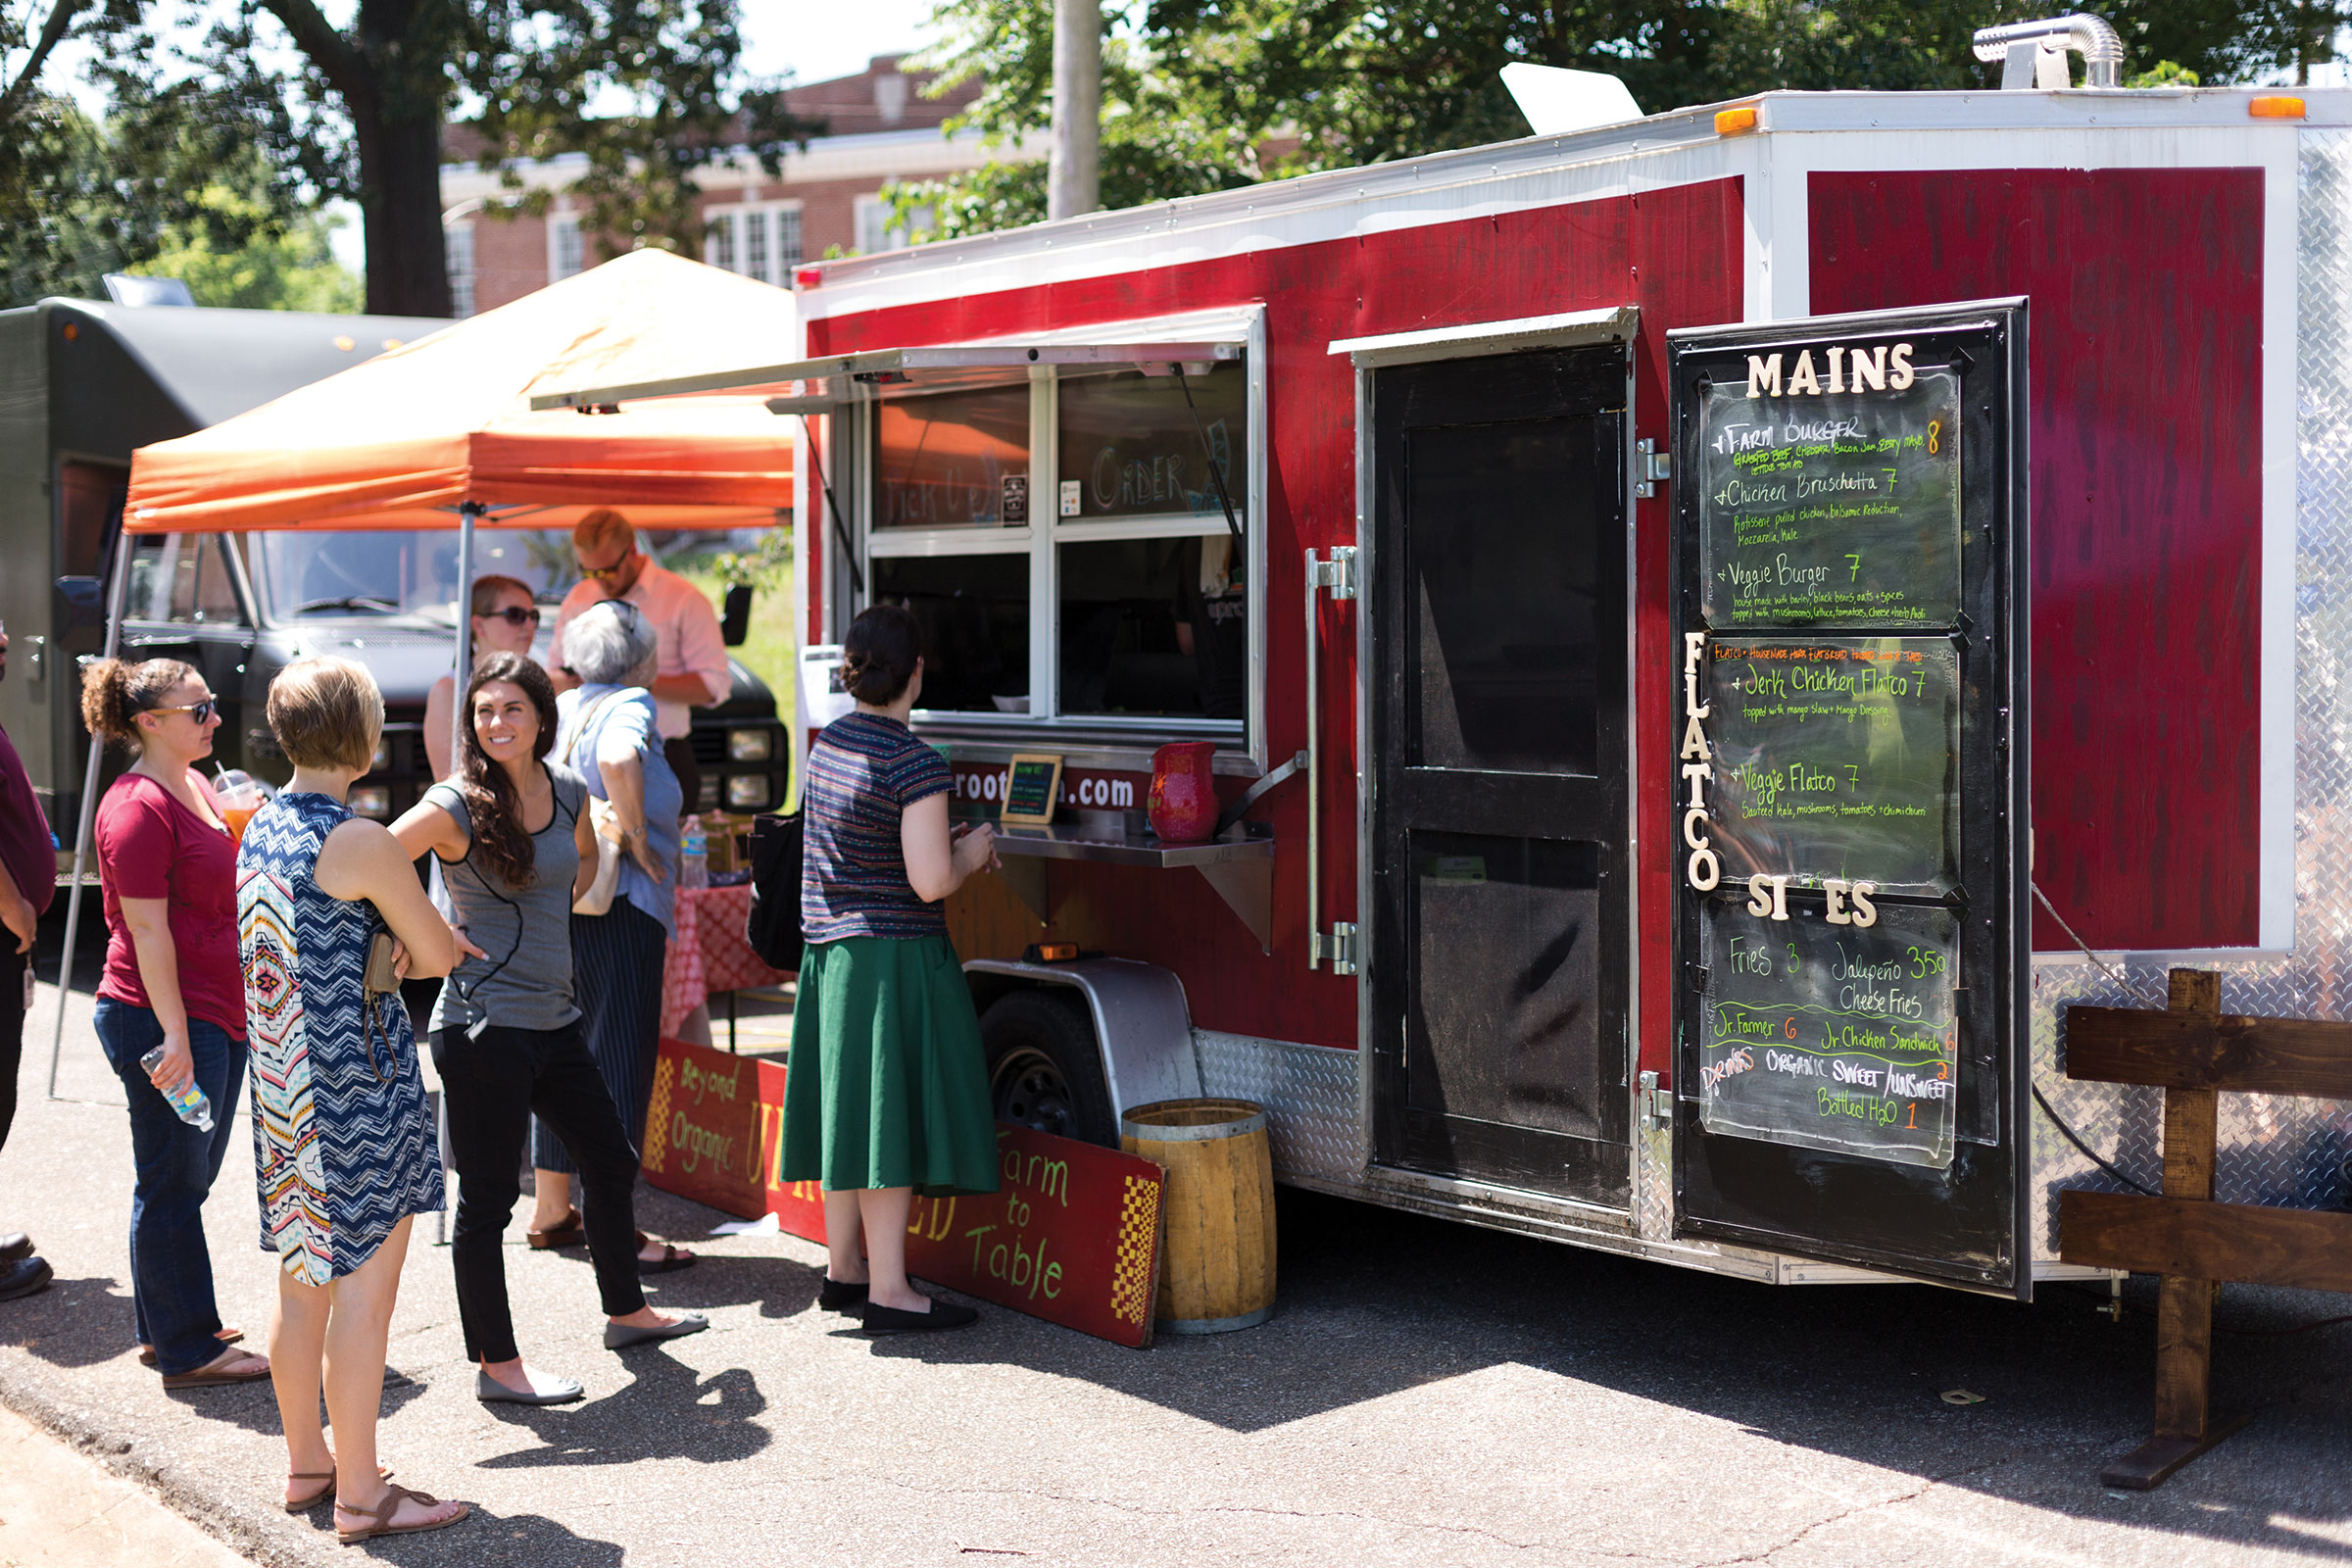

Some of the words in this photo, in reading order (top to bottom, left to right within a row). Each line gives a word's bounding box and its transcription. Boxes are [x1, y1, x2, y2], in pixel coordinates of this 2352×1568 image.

[1745, 343, 1914, 399] MAINS
[1724, 423, 1775, 455] FARM
[1784, 415, 1867, 448] BURGER
[1928, 420, 1939, 454] 8
[1833, 442, 1859, 455] Bacon
[1092, 446, 1187, 511] ORDER
[1727, 479, 1787, 507] Chicken
[1796, 471, 1878, 498] Bruschetta
[1882, 467, 1898, 493] 7
[1728, 561, 1773, 599] Veggie
[1776, 553, 1831, 597] Burger
[1844, 554, 1860, 582] 7
[1745, 662, 1788, 699] Jerk
[1791, 665, 1858, 697] Chicken
[1861, 666, 1908, 697] Flatco
[1911, 670, 1927, 698] 7
[1742, 703, 1767, 723] topped
[1769, 703, 1785, 715] with
[1680, 632, 1720, 892] FLATCO
[1740, 761, 1786, 805] Veggie
[1789, 761, 1836, 793] Flatco
[1843, 764, 1860, 793] 7
[1730, 936, 1773, 976] Fries
[1787, 942, 1800, 973] 3
[1839, 982, 1886, 1012] Cheese
[1889, 988, 1922, 1019] Fries
[1785, 1017, 1796, 1040] 6
[1889, 1025, 1943, 1055] Sandwich
[1944, 1032, 1955, 1052] 6
[681, 1057, 741, 1105] Beyond
[1765, 1049, 1829, 1079] ORGANIC
[1936, 1061, 1948, 1080] 2
[1817, 1087, 1864, 1119] Bottled
[1903, 1102, 1918, 1129] 1
[671, 1110, 735, 1174] Organic
[1006, 1192, 1030, 1227] to
[965, 1224, 1062, 1299] Table
